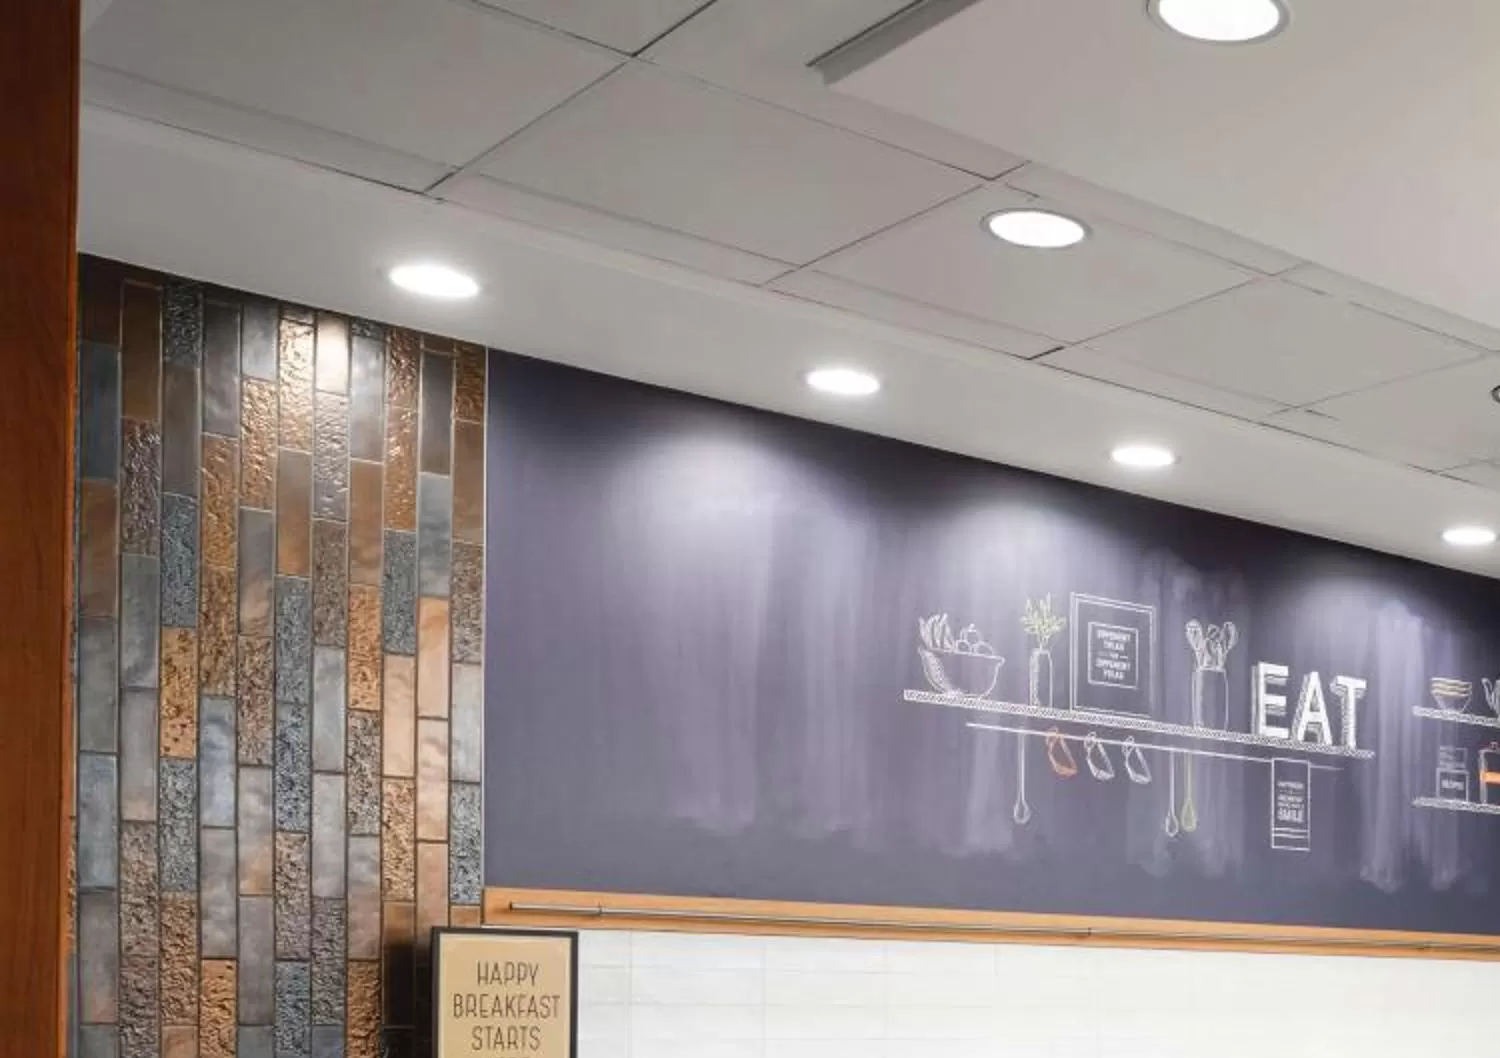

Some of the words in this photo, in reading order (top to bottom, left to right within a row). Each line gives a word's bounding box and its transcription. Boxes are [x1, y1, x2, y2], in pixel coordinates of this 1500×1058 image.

[1251, 661, 1367, 749] EAT
[476, 960, 540, 986] HAPPY
[452, 993, 561, 1019] BREAKFAST
[471, 1025, 542, 1051] STARTS
